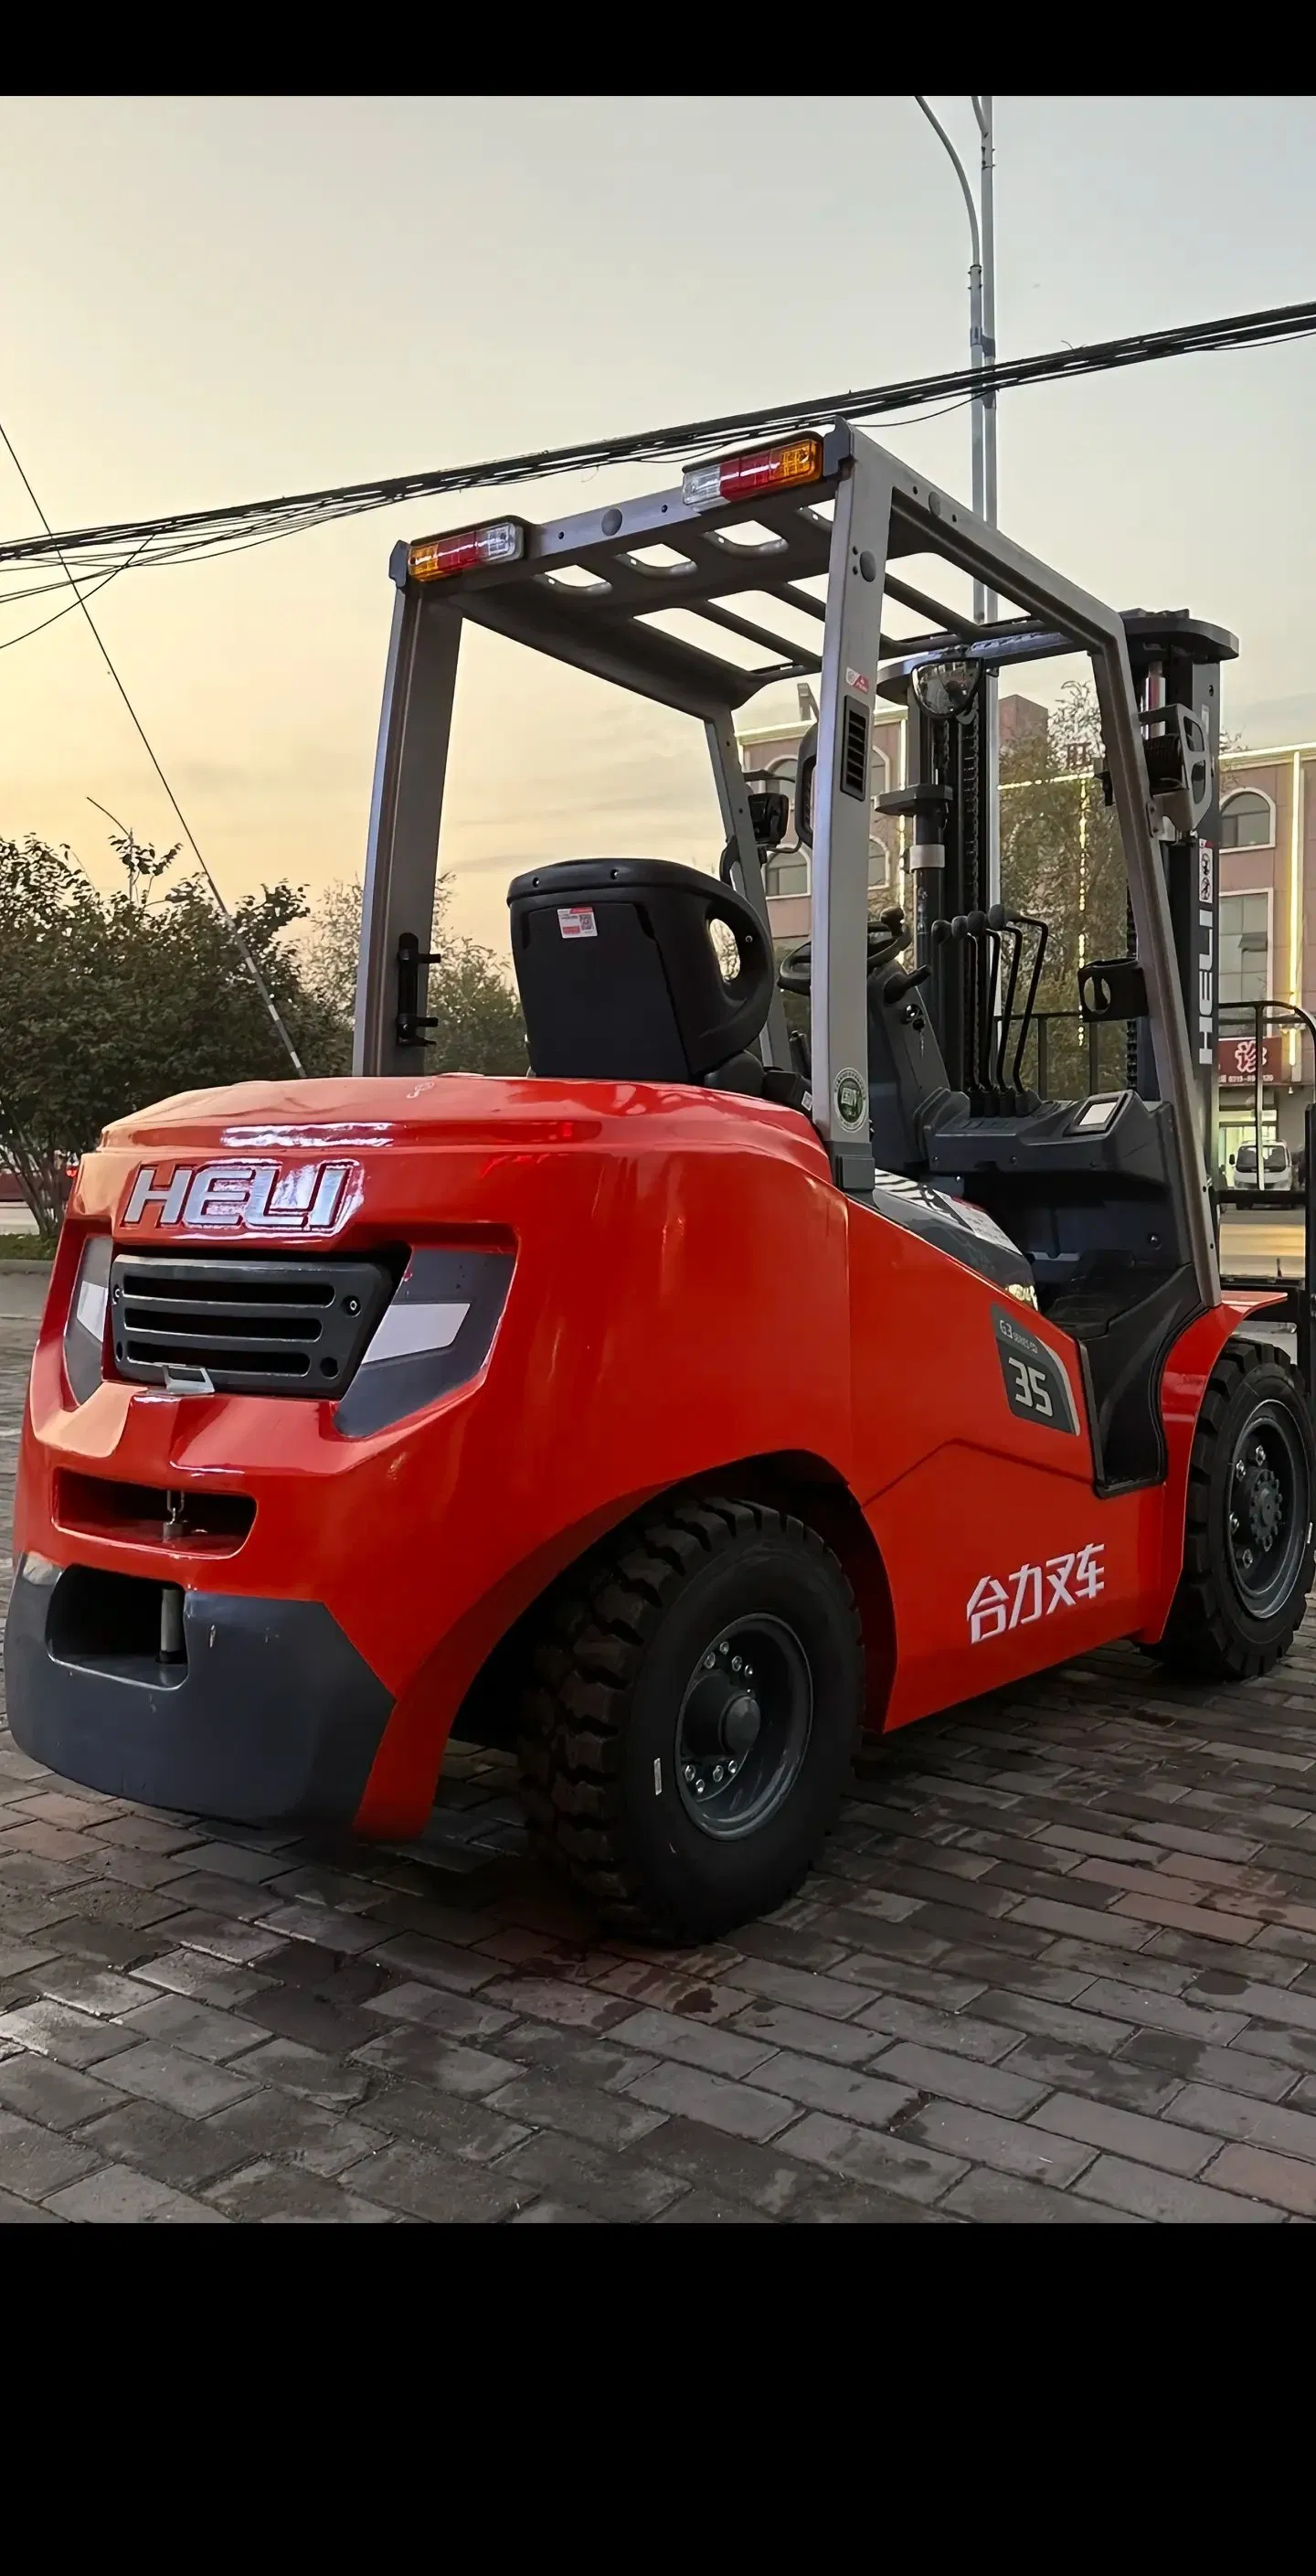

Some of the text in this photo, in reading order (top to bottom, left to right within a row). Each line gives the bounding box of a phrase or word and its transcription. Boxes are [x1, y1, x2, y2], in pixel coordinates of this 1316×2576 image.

[1199, 910, 1213, 1065] HELI
[123, 1164, 348, 1227] HELI
[1008, 1357, 1053, 1417] 35
[966, 1543, 1105, 1645] 合力叉车
